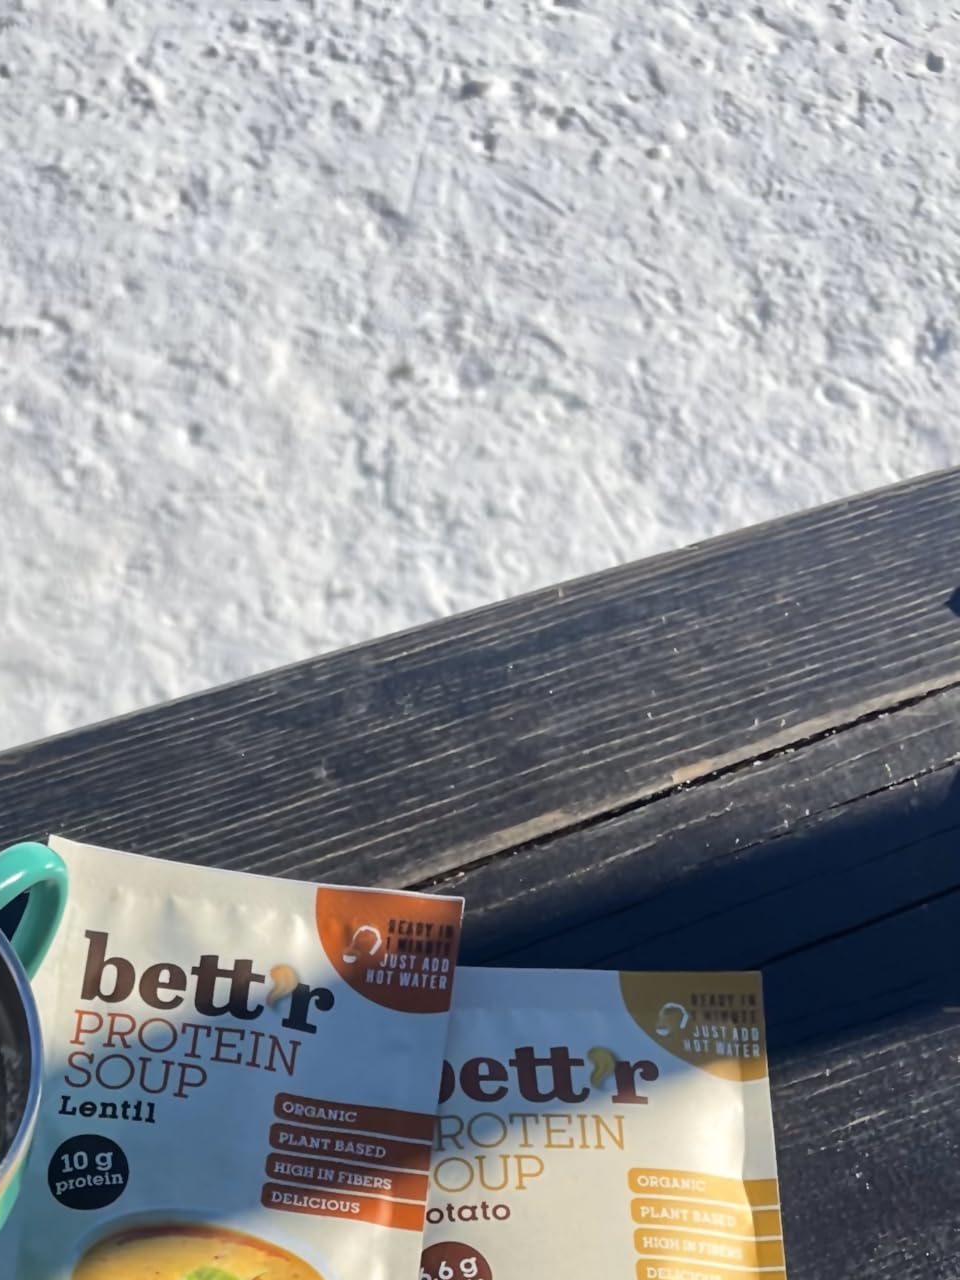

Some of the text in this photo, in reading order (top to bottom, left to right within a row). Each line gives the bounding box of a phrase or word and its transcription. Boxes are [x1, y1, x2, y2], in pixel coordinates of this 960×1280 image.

[380, 953, 449, 973] JUST ADD
[366, 968, 447, 989] HOT WATER
[69, 1009, 301, 1076] PROTEIN
[693, 1025, 760, 1042] JUST ADD
[683, 1039, 760, 1058] HOT WATER
[64, 1050, 207, 1098] SOUP
[58, 1095, 156, 1123] Lentil
[282, 1101, 357, 1123] ORGANIC
[435, 1112, 624, 1153] ROTEIN
[278, 1131, 386, 1158] PLANT BASED
[60, 1149, 114, 1172] 10 g
[55, 1171, 124, 1196] protein
[273, 1161, 392, 1190] HIGH IN FIBERS
[433, 1154, 545, 1193] OUP
[637, 1175, 705, 1192] ORGANIC
[271, 1191, 360, 1214] DELICIOUS
[426, 1201, 511, 1225] otato
[640, 1206, 688, 1221] PLANT
[642, 1236, 680, 1249] HIGH
[459, 1256, 478, 1278] g
